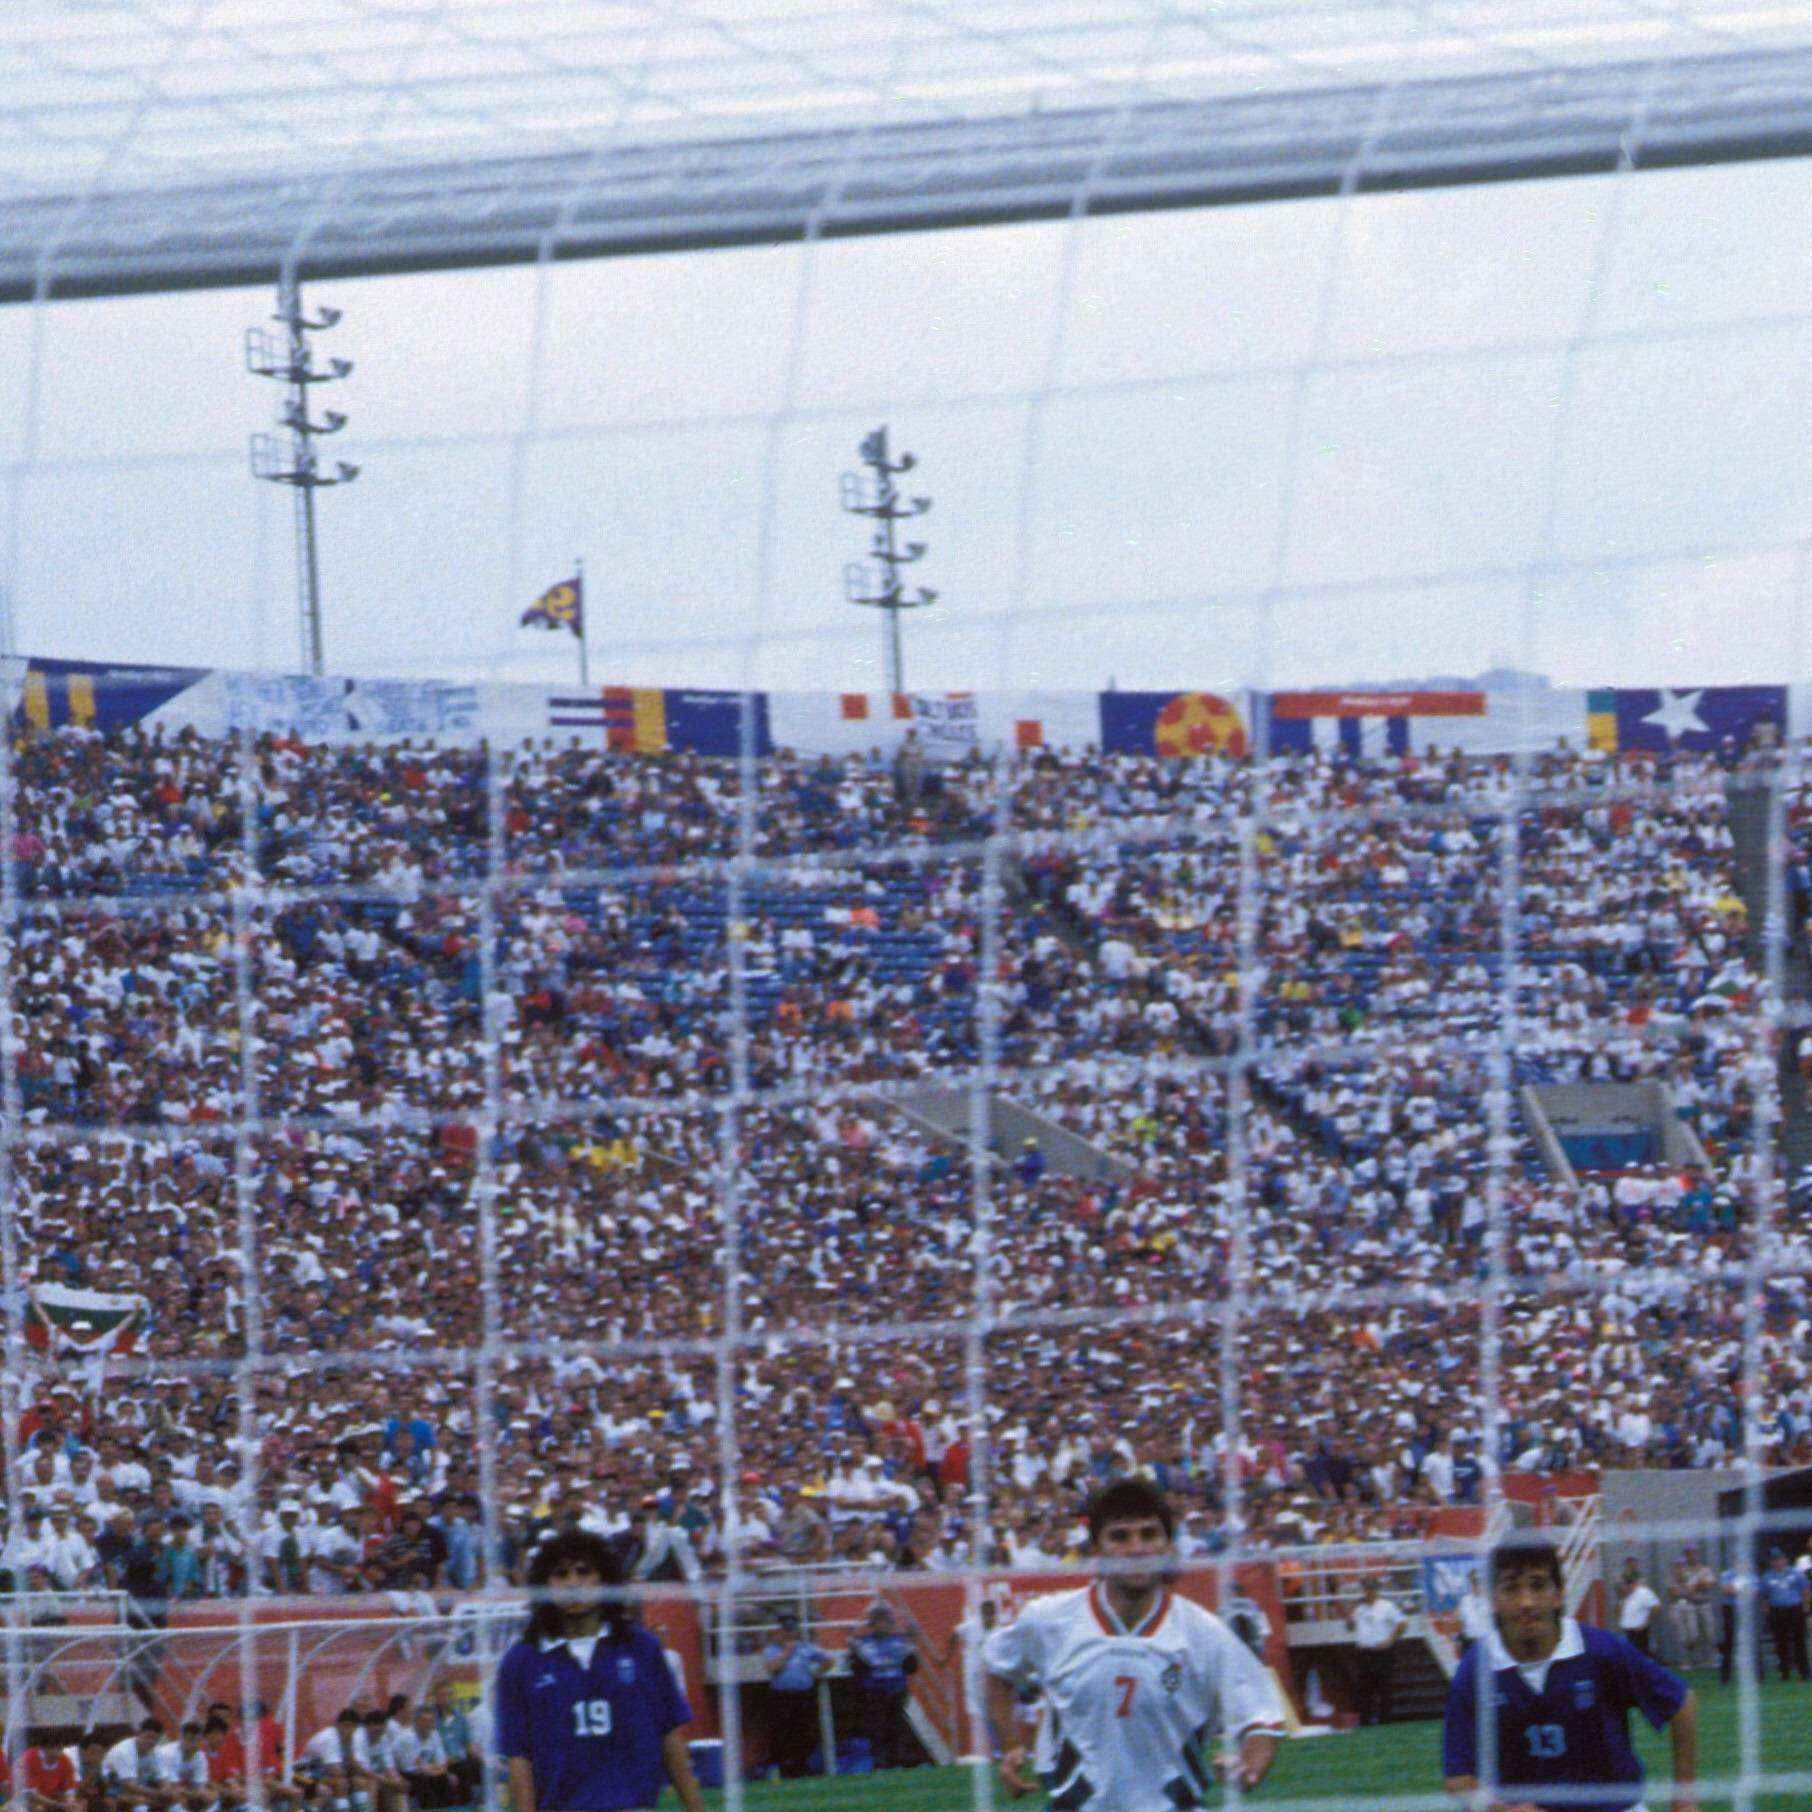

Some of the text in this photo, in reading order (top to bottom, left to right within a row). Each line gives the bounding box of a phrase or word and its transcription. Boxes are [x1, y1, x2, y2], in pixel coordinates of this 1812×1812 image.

[1114, 1675, 1137, 1718] 7
[571, 1700, 612, 1736] 19
[1523, 1722, 1566, 1758] 13
